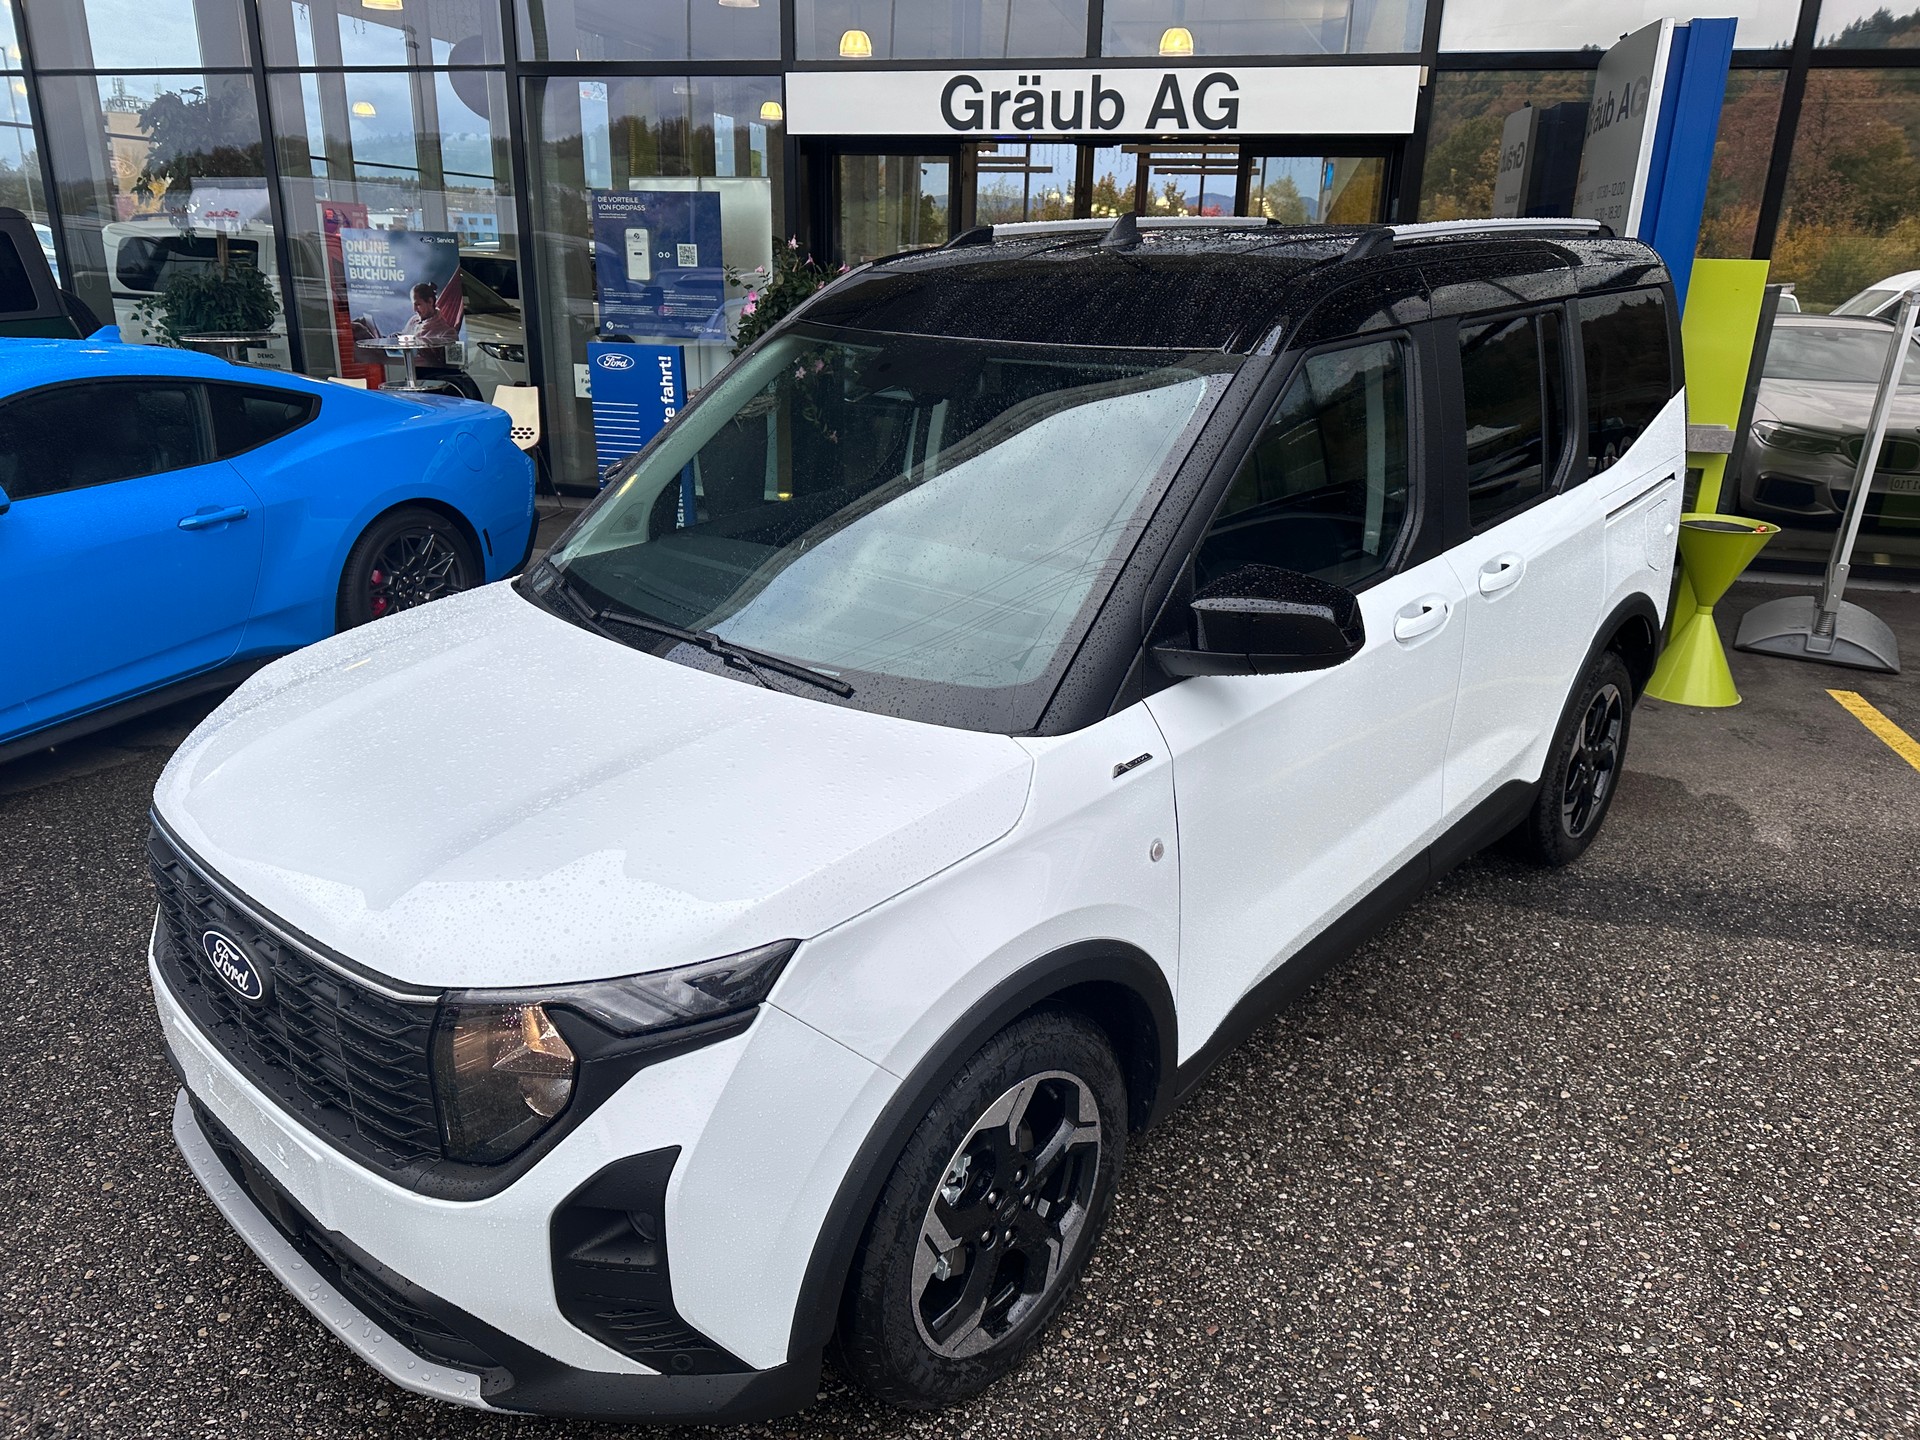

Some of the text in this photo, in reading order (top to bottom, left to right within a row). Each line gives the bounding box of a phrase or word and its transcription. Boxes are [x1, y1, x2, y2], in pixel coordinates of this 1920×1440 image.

[107, 97, 141, 109] HOTEL
[940, 71, 1240, 132] Gräub AG
[1616, 75, 1648, 123] AG
[608, 196, 639, 204] VORTEILE
[345, 240, 390, 253] ONLINE
[348, 253, 396, 267] SERVICE
[349, 267, 405, 281] BUCHUNG
[602, 354, 629, 369] Ford
[658, 356, 675, 404] fahrt!
[211, 938, 251, 992] Ford
